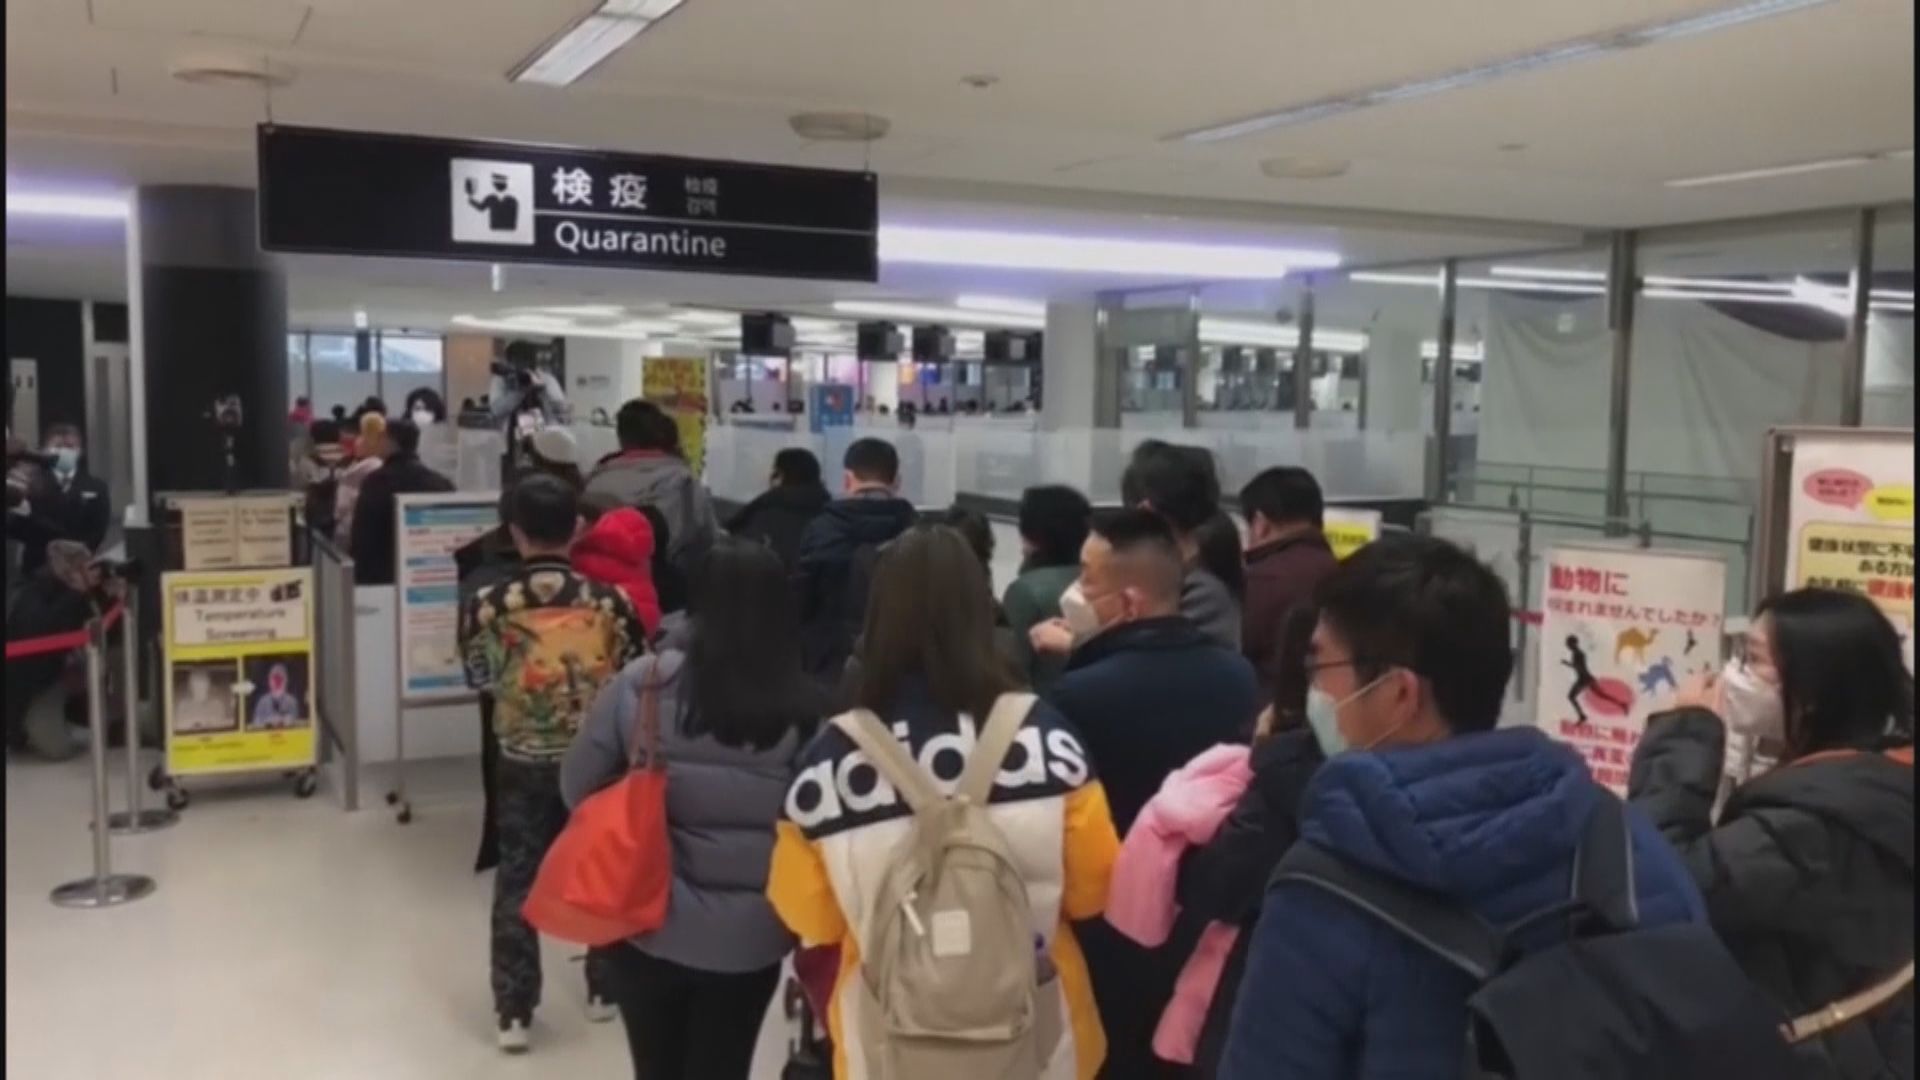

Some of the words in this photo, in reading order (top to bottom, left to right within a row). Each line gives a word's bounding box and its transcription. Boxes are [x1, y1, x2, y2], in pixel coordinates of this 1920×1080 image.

[552, 166, 647, 210] 検疫
[555, 220, 727, 258] Quarantine
[1551, 564, 1630, 597] 動物に
[195, 607, 286, 623] Temperature
[206, 626, 276, 641] Screening
[785, 711, 1088, 828] adidas
